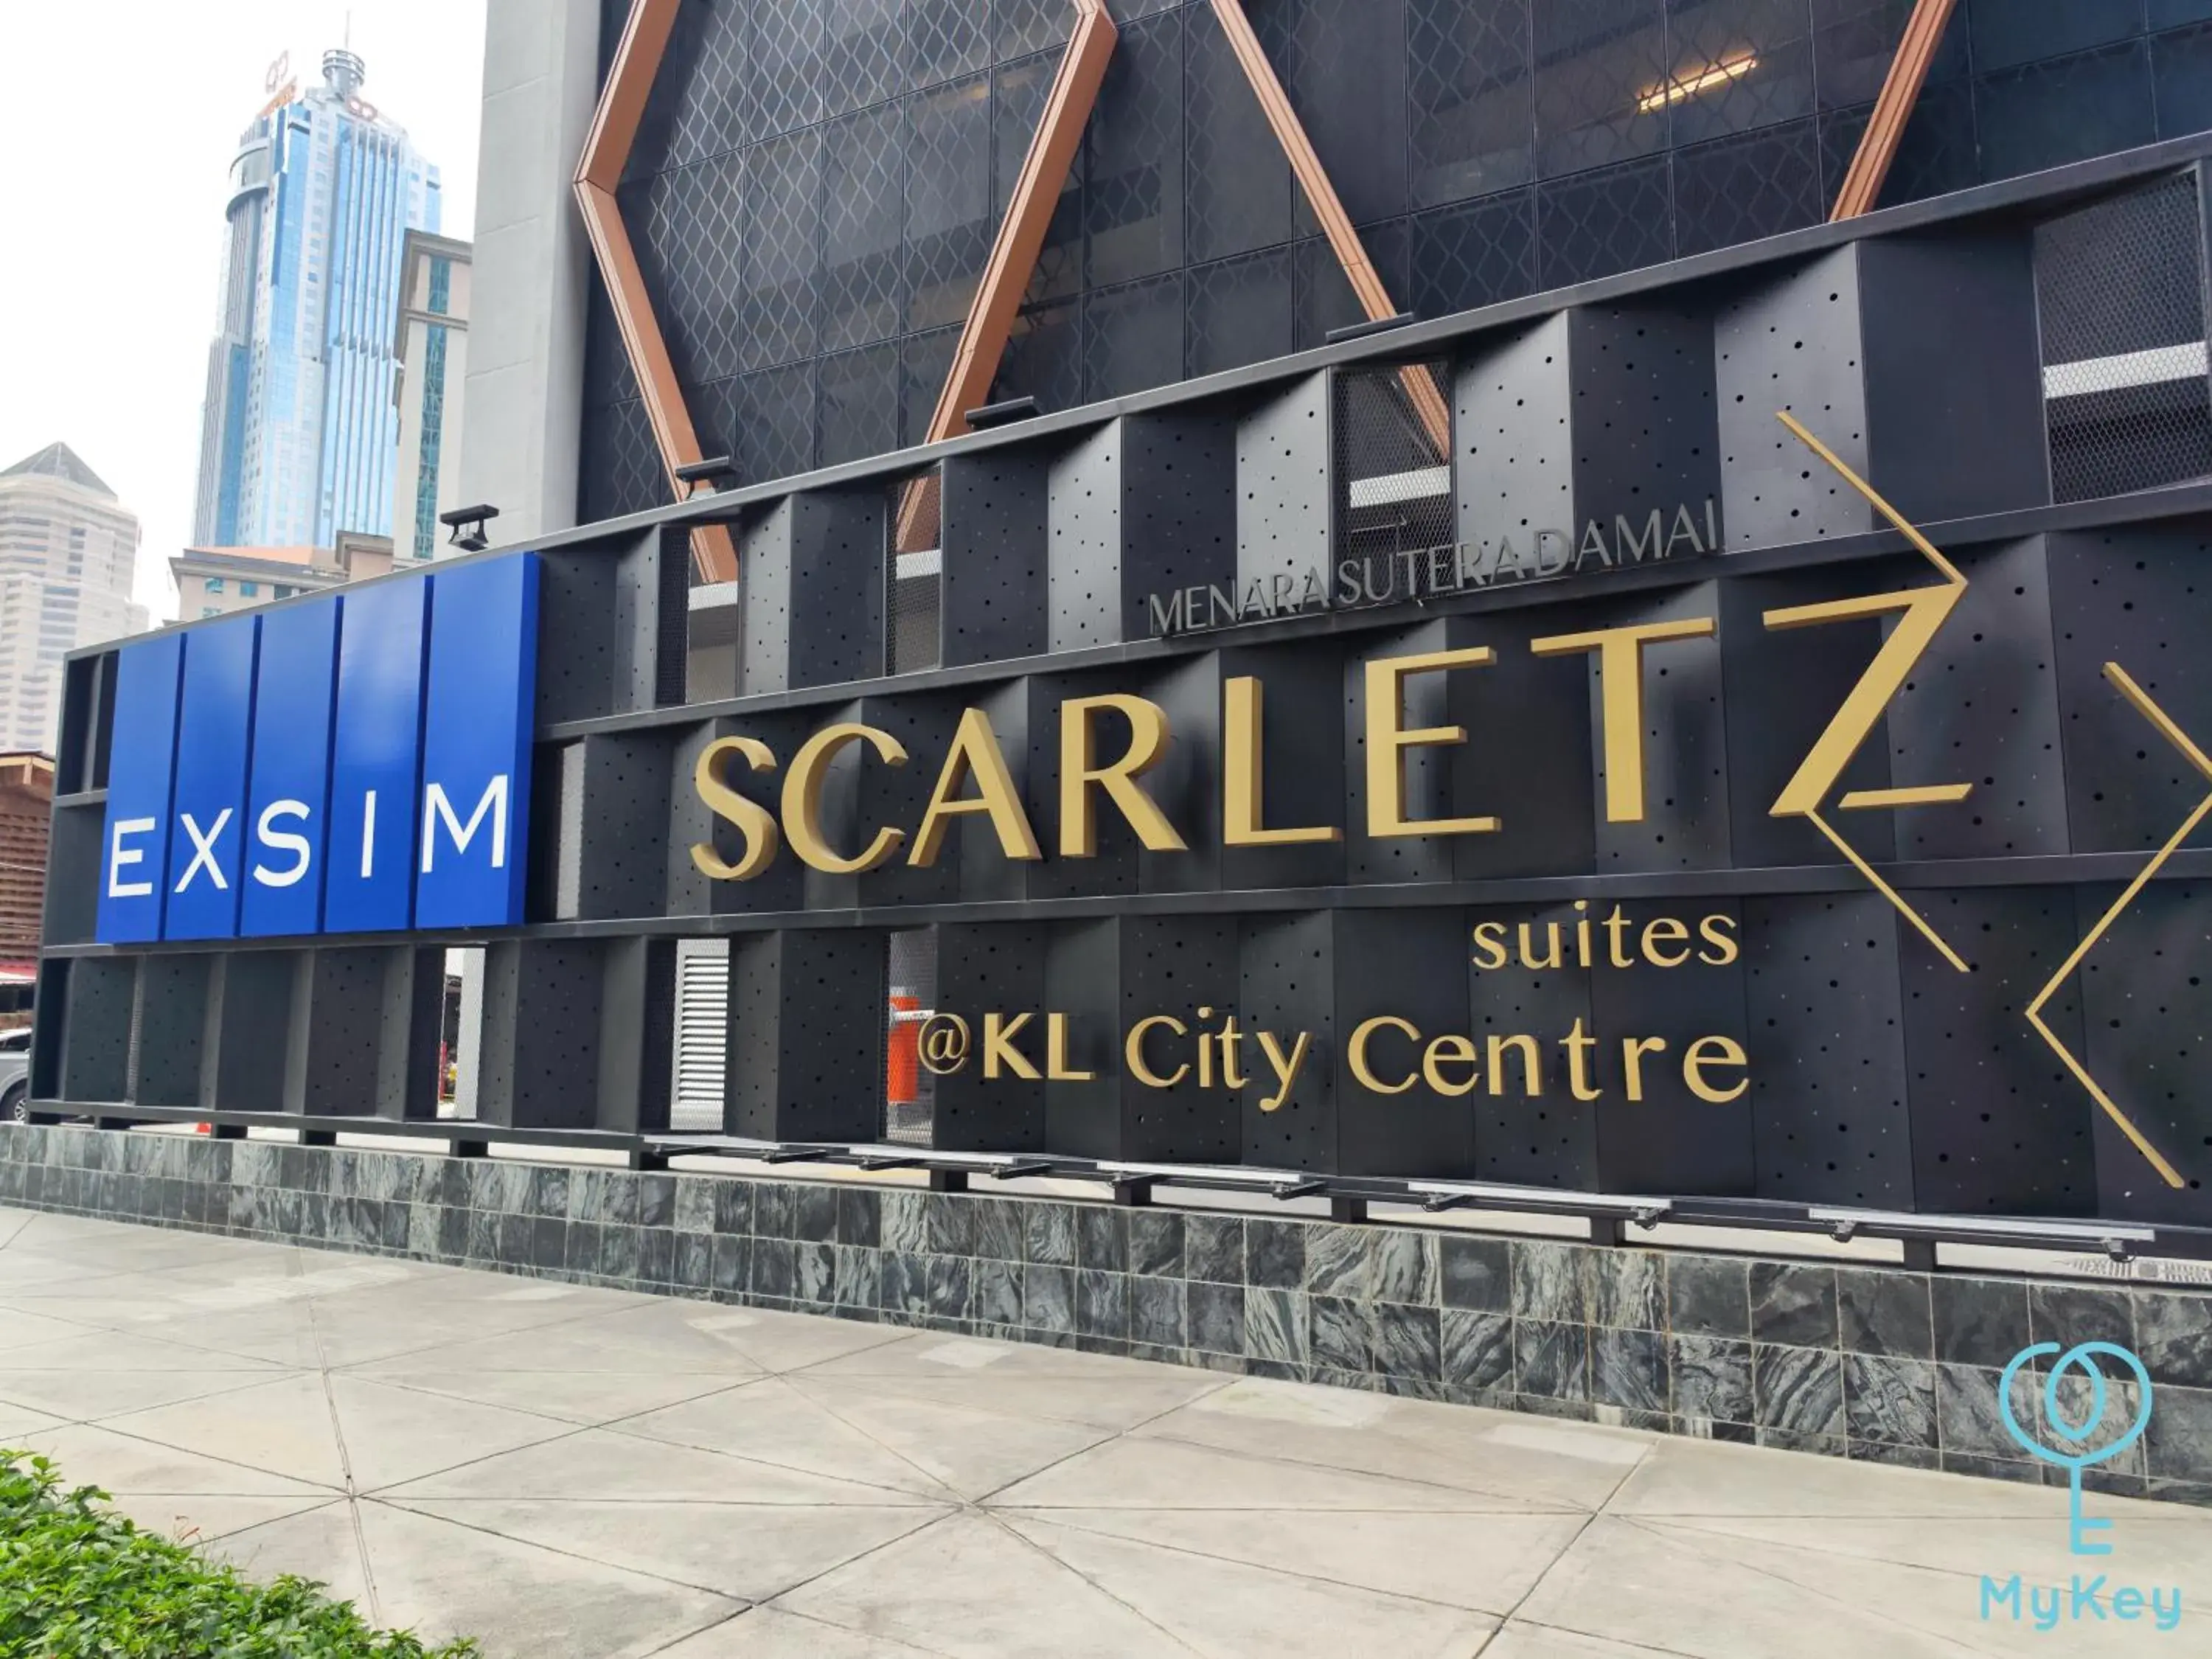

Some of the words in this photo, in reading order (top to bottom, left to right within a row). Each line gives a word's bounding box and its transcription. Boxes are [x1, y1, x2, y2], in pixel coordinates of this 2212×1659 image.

[1148, 566, 1331, 637] MENARA
[1335, 538, 1525, 605] SUTERA
[1533, 498, 1720, 576] DAMAI
[690, 581, 1975, 881] SCARLETZ
[108, 774, 509, 898] EXSIM
[1472, 899, 1739, 970] suites
[917, 1012, 1095, 1082] @KL
[1125, 1006, 1310, 1112] City
[1348, 1015, 1751, 1105] Centre
